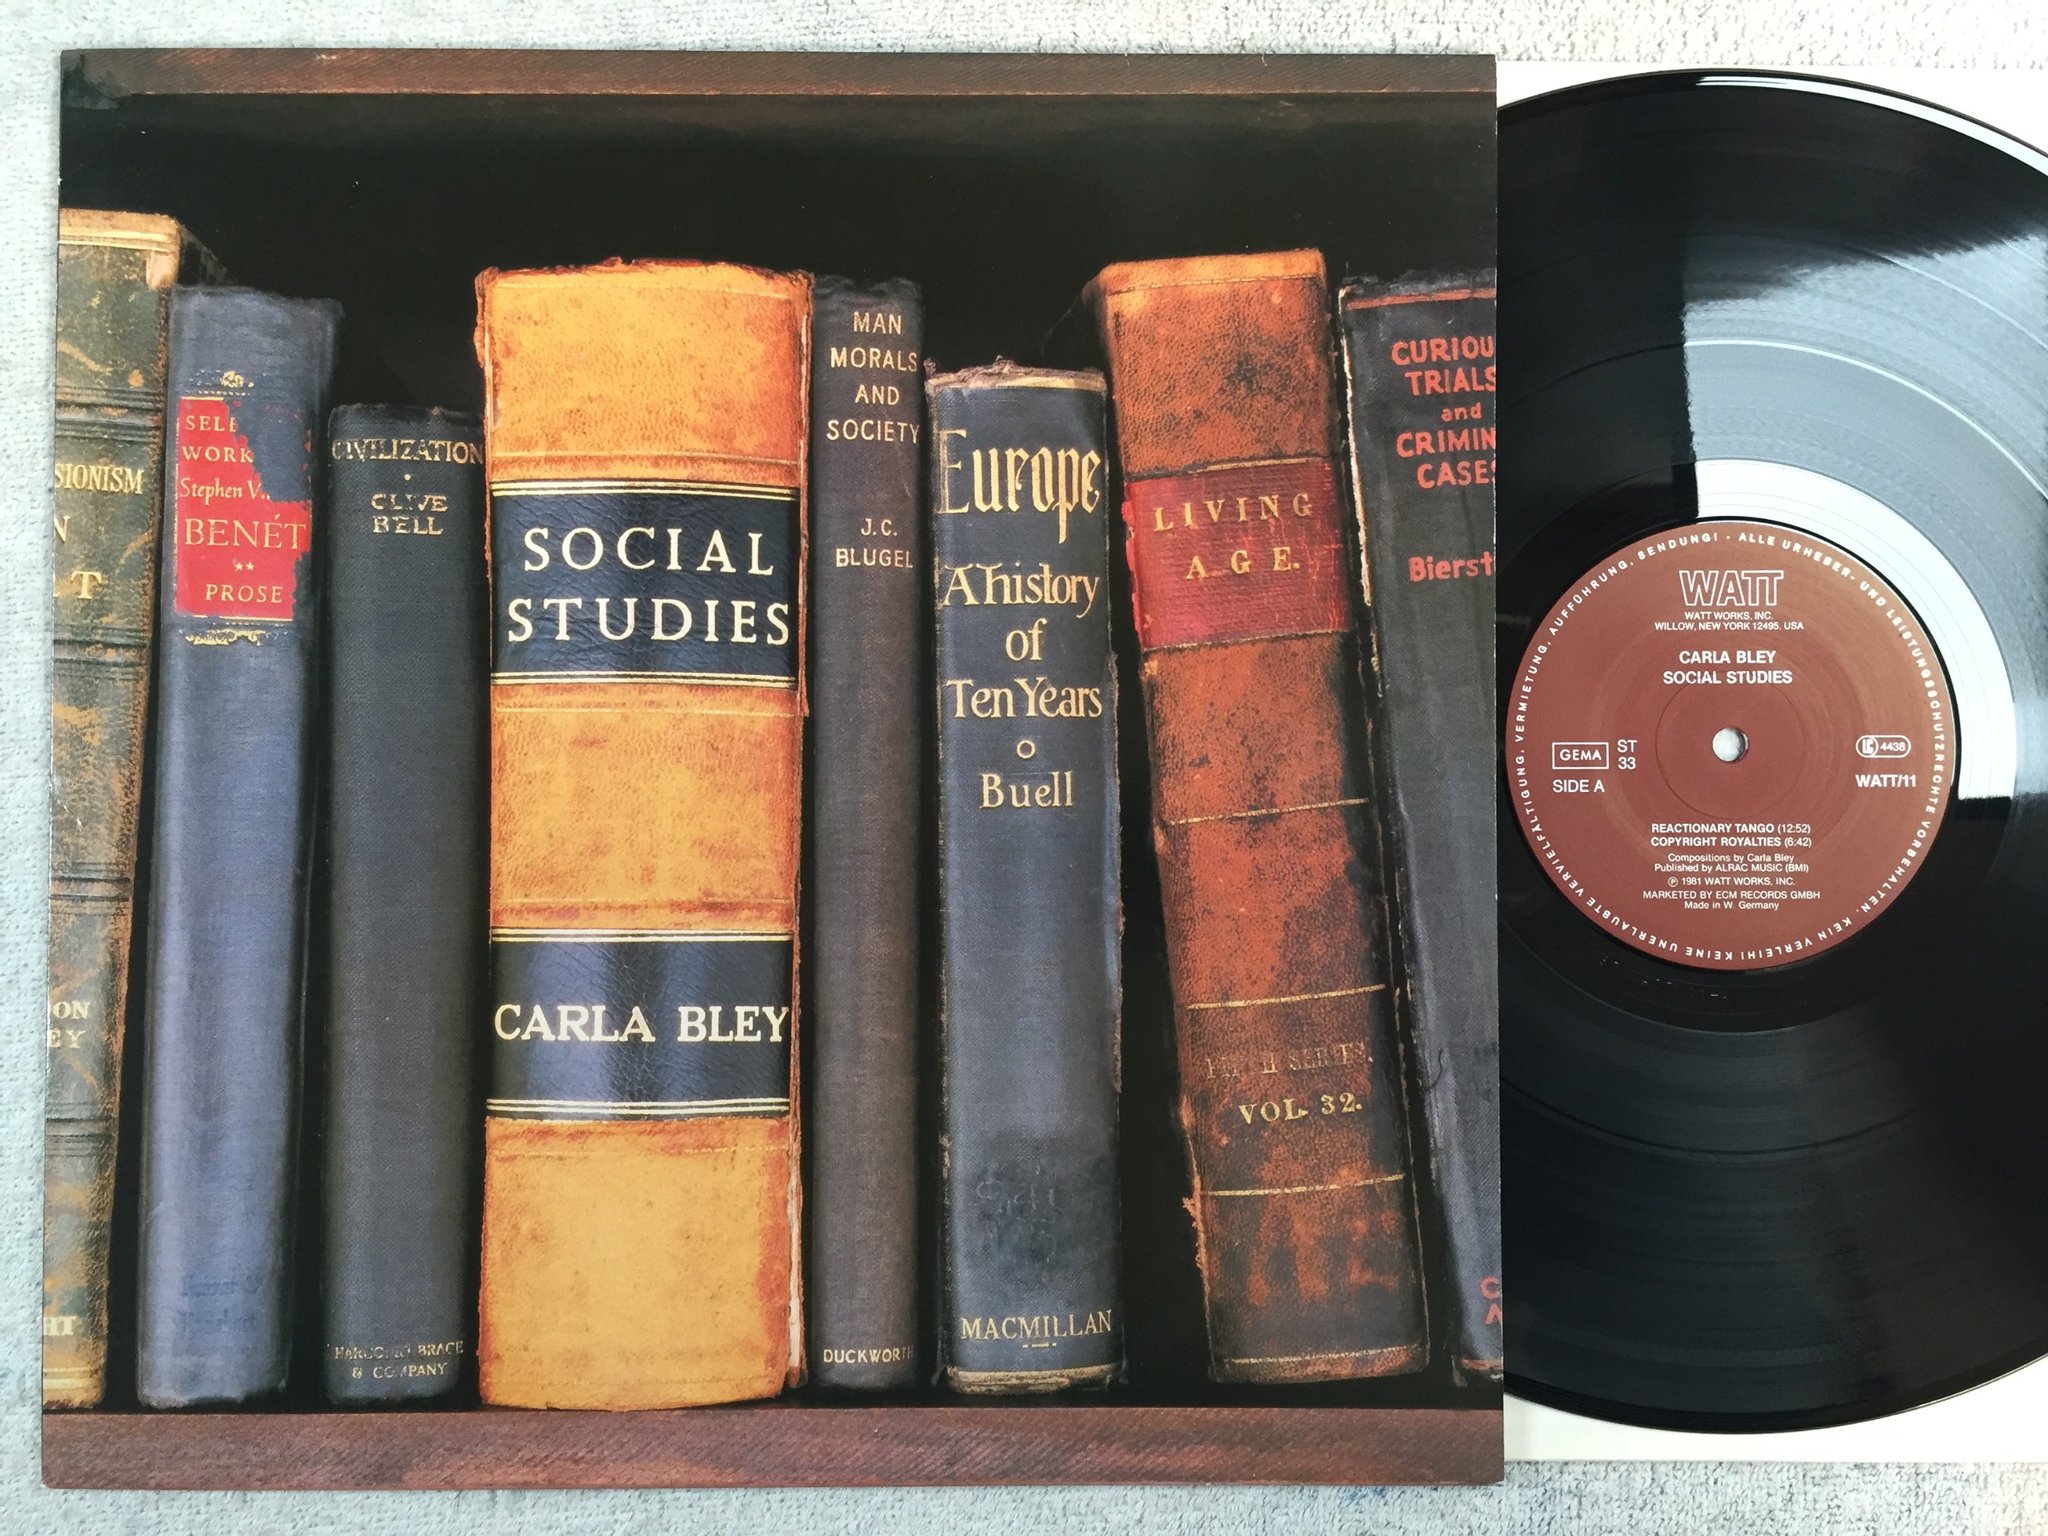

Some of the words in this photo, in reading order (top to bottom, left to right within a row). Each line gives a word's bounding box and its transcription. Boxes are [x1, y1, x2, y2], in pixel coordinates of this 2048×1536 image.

[853, 312, 902, 334] MAN
[830, 347, 917, 372] MORALS
[1392, 336, 1495, 366] CURIOU
[1405, 366, 1496, 396] TRIALS
[854, 384, 900, 405] AND
[1441, 402, 1482, 422] and
[826, 419, 920, 444] SOCIETY
[332, 438, 484, 464] CIVILIZATION
[1396, 427, 1496, 458] CRIMIN
[182, 446, 253, 463] WORK
[180, 477, 242, 505] Stephen
[936, 429, 1101, 544] Europe
[1154, 493, 1313, 531] LIVING
[185, 513, 306, 550] BENÉT
[373, 516, 444, 535] BELL
[861, 518, 898, 536] J.C.
[1738, 532, 1776, 546] ALLE
[524, 526, 774, 576] SOCIAL
[1782, 539, 1856, 580] URHEBER-
[1409, 551, 1493, 582] Bierst
[206, 584, 283, 603] PROSE
[1679, 570, 1784, 606] WATT
[1859, 581, 1887, 607] UND
[507, 597, 789, 645] STUDIES
[1684, 612, 1712, 620] WATT
[1754, 612, 1774, 620] INC.
[1698, 622, 1722, 631] NEW
[1723, 622, 1750, 630] YORK
[1784, 622, 1804, 630] USA
[1005, 617, 1048, 661] of
[1679, 651, 1731, 664] CARLA
[1736, 651, 1776, 664] BLEY
[1663, 670, 1721, 684] SOCIAL
[1726, 670, 1793, 684] STUDIES
[945, 678, 1017, 718] Ten
[1013, 677, 1103, 718] Years
[1560, 749, 1602, 761] GEMA
[1617, 739, 1637, 753] ST
[1880, 742, 1906, 752] 4438
[1618, 757, 1637, 770] 33
[979, 770, 1073, 809] Buell
[1552, 779, 1589, 793] SIDE
[1593, 779, 1606, 793] A
[1855, 774, 1917, 788] WATT/11
[1652, 824, 1732, 834] REACTIONARY
[1735, 824, 1774, 834] TANGO
[1777, 824, 1811, 834] (12:52)
[1651, 837, 1717, 847] COPYRIGHT
[1721, 837, 1782, 847] ROYALTIES
[1784, 837, 1812, 848] (6:42)
[1655, 863, 1699, 872] Published
[1702, 864, 1712, 874] by
[1716, 864, 1748, 872] ALRAC
[1751, 864, 1783, 872] MUSIC
[1785, 864, 1809, 873] (BMI)
[1668, 853, 1731, 863] Compositions
[1734, 854, 1744, 864] by
[1747, 853, 1772, 862] Carla
[1775, 853, 1794, 864] Bley
[1682, 877, 1702, 886] 1981
[1704, 877, 1731, 886] WATT
[1776, 877, 1795, 886] INC.
[1643, 891, 1697, 899] MARKETED
[1700, 891, 1713, 899] BY
[1716, 891, 1738, 899] ECM
[1741, 891, 1787, 899] RECORDS
[1790, 891, 1820, 899] GMBH
[1684, 901, 1710, 909] Made
[1713, 901, 1721, 909] in
[1738, 901, 1779, 911] Germany
[1587, 897, 1678, 952] UNERLAUBTE
[1817, 916, 1852, 941] KEIN
[1685, 946, 1733, 961] KEINE
[52, 1001, 90, 1019] ON
[494, 1004, 656, 1043] CARLA
[677, 1005, 789, 1042] BLEY
[1238, 1098, 1308, 1125] VOL.
[1321, 1092, 1362, 1115] 32.
[960, 1309, 1112, 1340] MACMILLAN
[418, 1341, 464, 1357] BRACE
